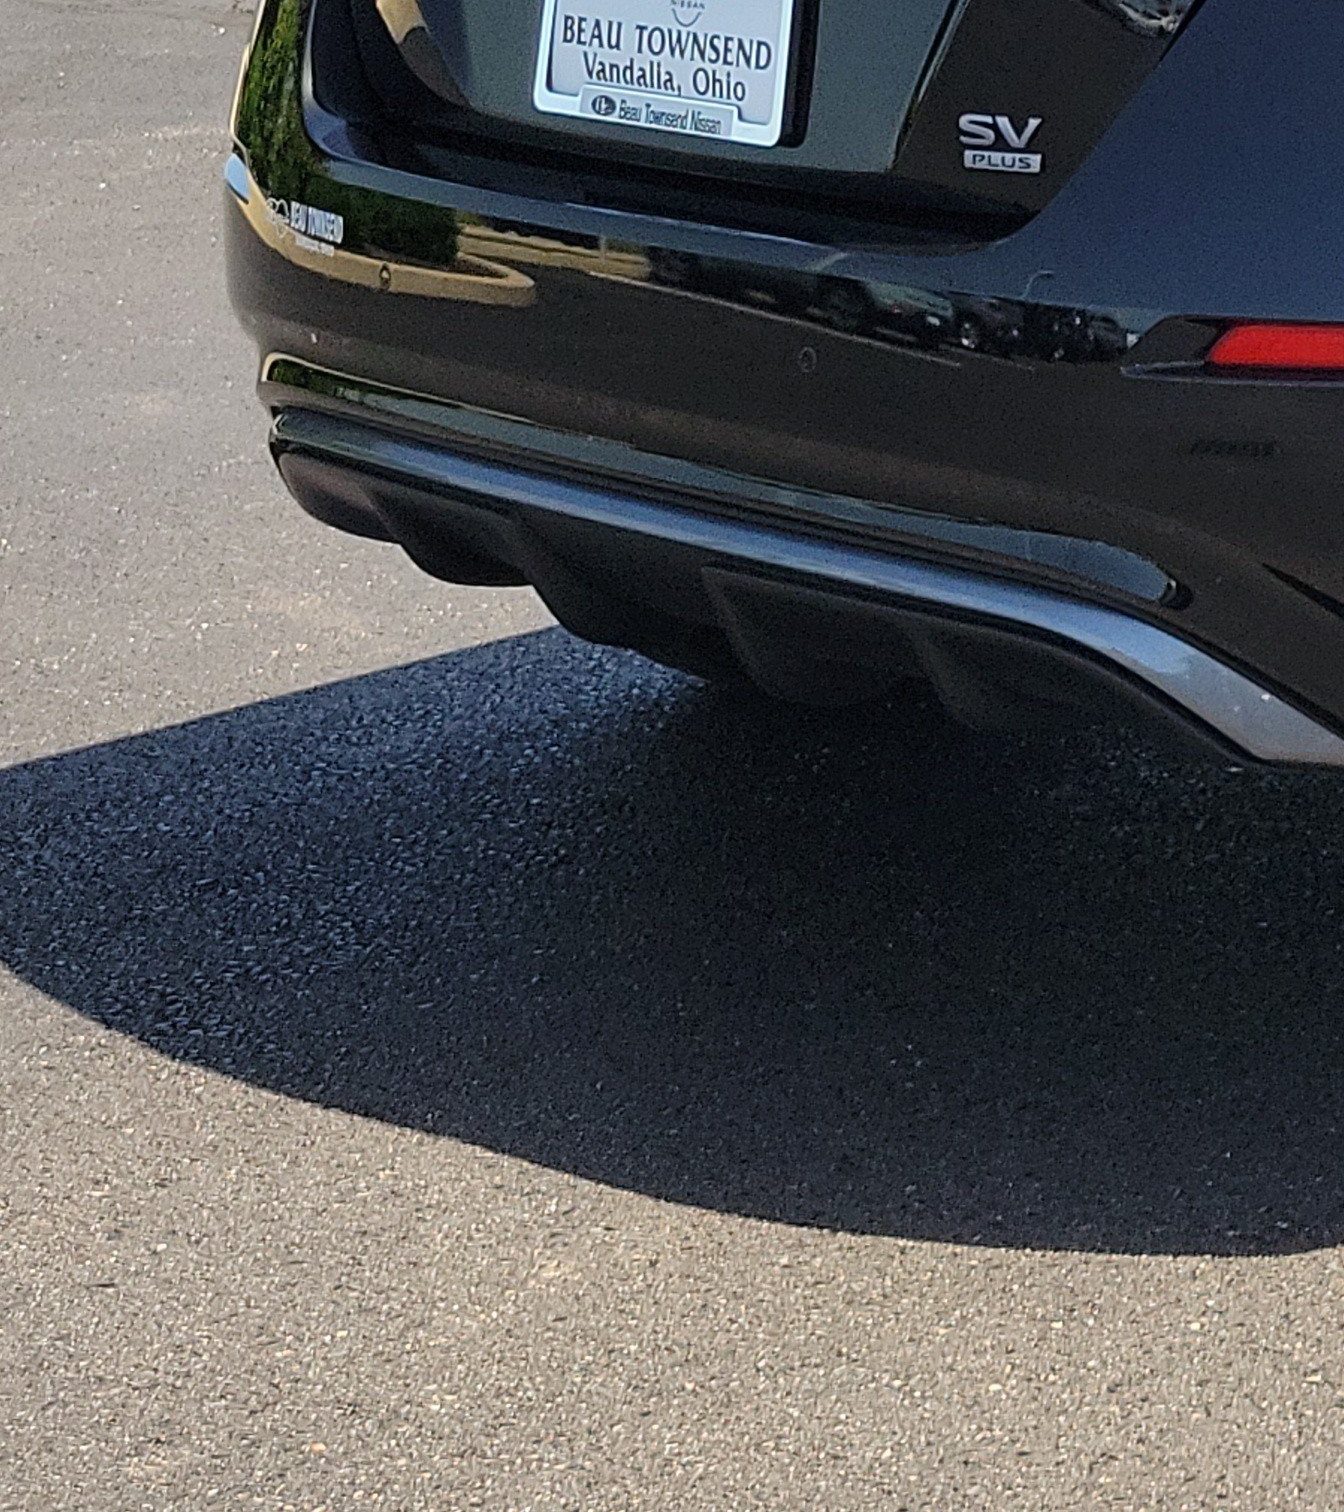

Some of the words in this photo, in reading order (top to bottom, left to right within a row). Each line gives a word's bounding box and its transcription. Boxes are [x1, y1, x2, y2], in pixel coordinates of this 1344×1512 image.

[562, 14, 623, 51] BEAU
[635, 24, 772, 71] TOWNSEND
[583, 51, 682, 97] Vandalia,
[693, 67, 747, 102] Ohio
[618, 99, 643, 123] Beau
[645, 103, 689, 130] Townsend
[690, 109, 723, 135] Nissan
[958, 113, 1043, 149] SV
[972, 154, 1032, 169] PLUS
